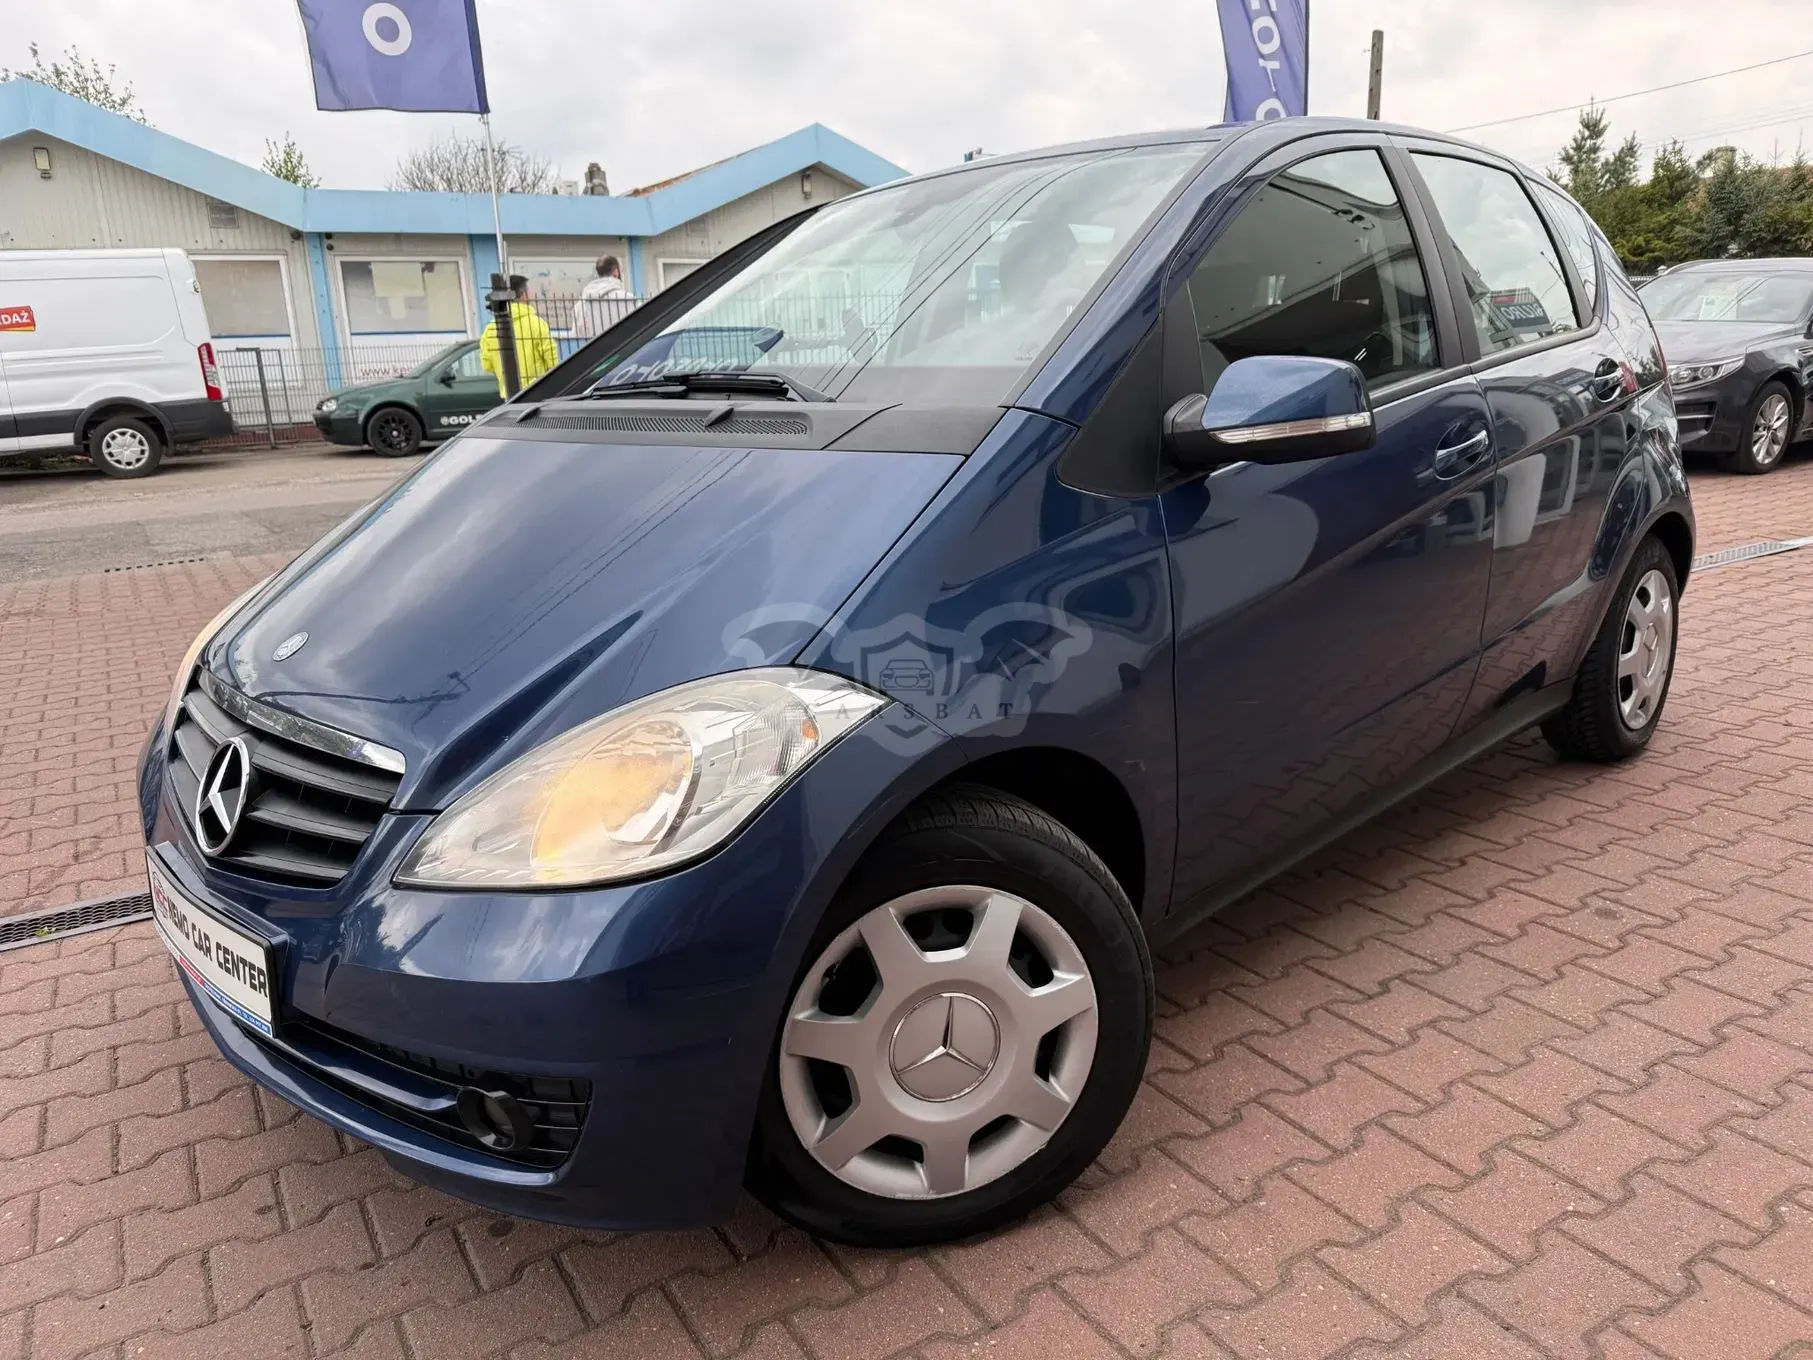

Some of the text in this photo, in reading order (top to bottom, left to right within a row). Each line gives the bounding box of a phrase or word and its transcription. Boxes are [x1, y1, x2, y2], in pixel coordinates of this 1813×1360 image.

[362, 2, 413, 56] O
[1251, 0, 1287, 121] OTO
[0, 310, 31, 325] DAŻ
[167, 896, 190, 941] NEMO
[191, 922, 213, 962] CAR
[216, 941, 268, 998] CENTER
